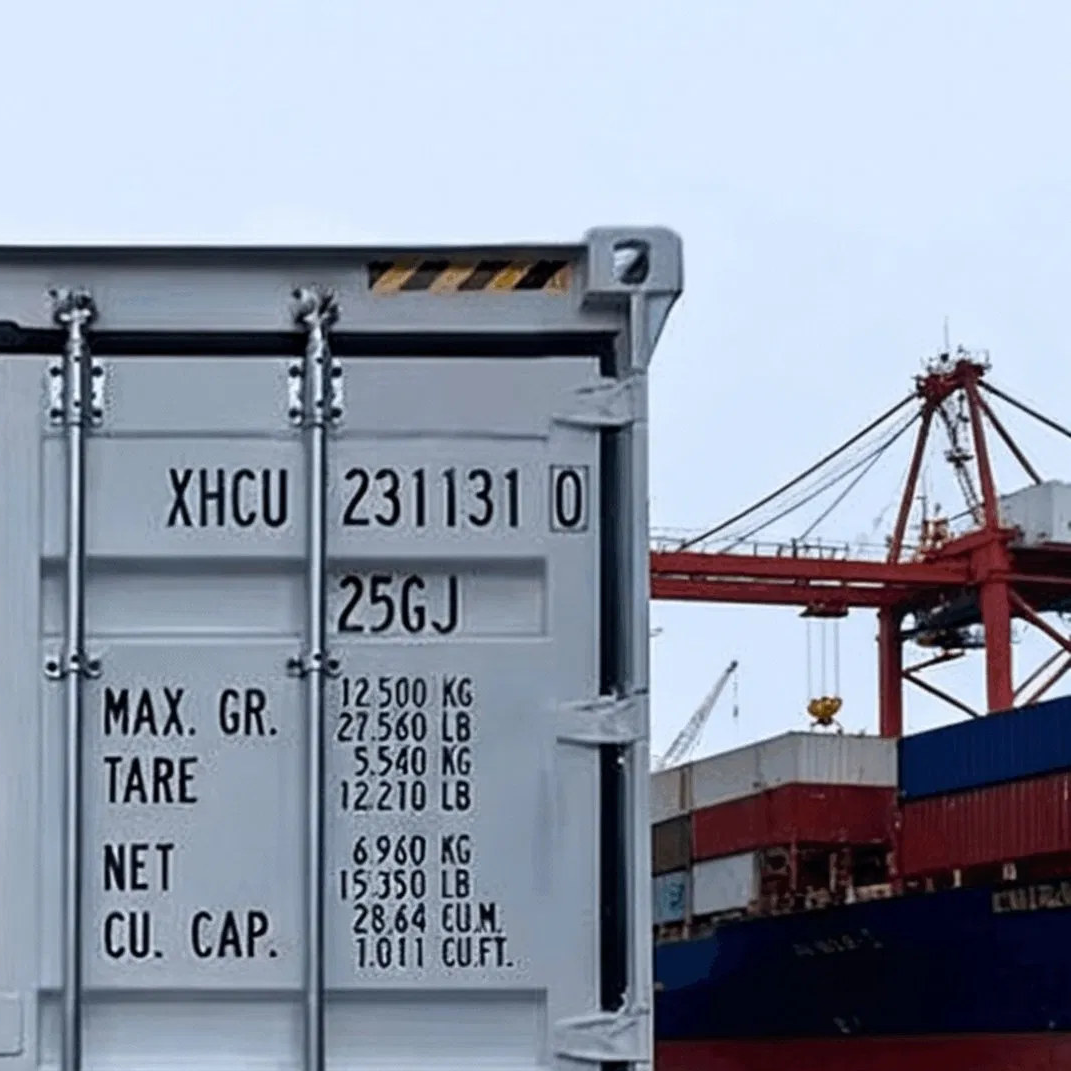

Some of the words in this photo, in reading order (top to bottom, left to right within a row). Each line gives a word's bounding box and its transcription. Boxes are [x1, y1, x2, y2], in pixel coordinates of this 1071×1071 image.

[167, 468, 288, 528] XHCU
[343, 467, 518, 528] 231131
[337, 574, 460, 635] 25GJ
[442, 677, 473, 708] KG
[104, 686, 196, 737] MAX.
[219, 688, 277, 737] GR.
[337, 711, 427, 743] 27.560
[441, 711, 471, 743] LB
[354, 745, 427, 777] 5.540
[441, 745, 471, 776] KG
[103, 756, 198, 804] TARE
[441, 780, 471, 812] LB
[441, 834, 471, 865] KG
[104, 843, 175, 891] NET
[441, 868, 470, 899] LB
[104, 911, 163, 959] CU.
[191, 910, 278, 958] CAP.
[356, 936, 423, 969] 1.011
